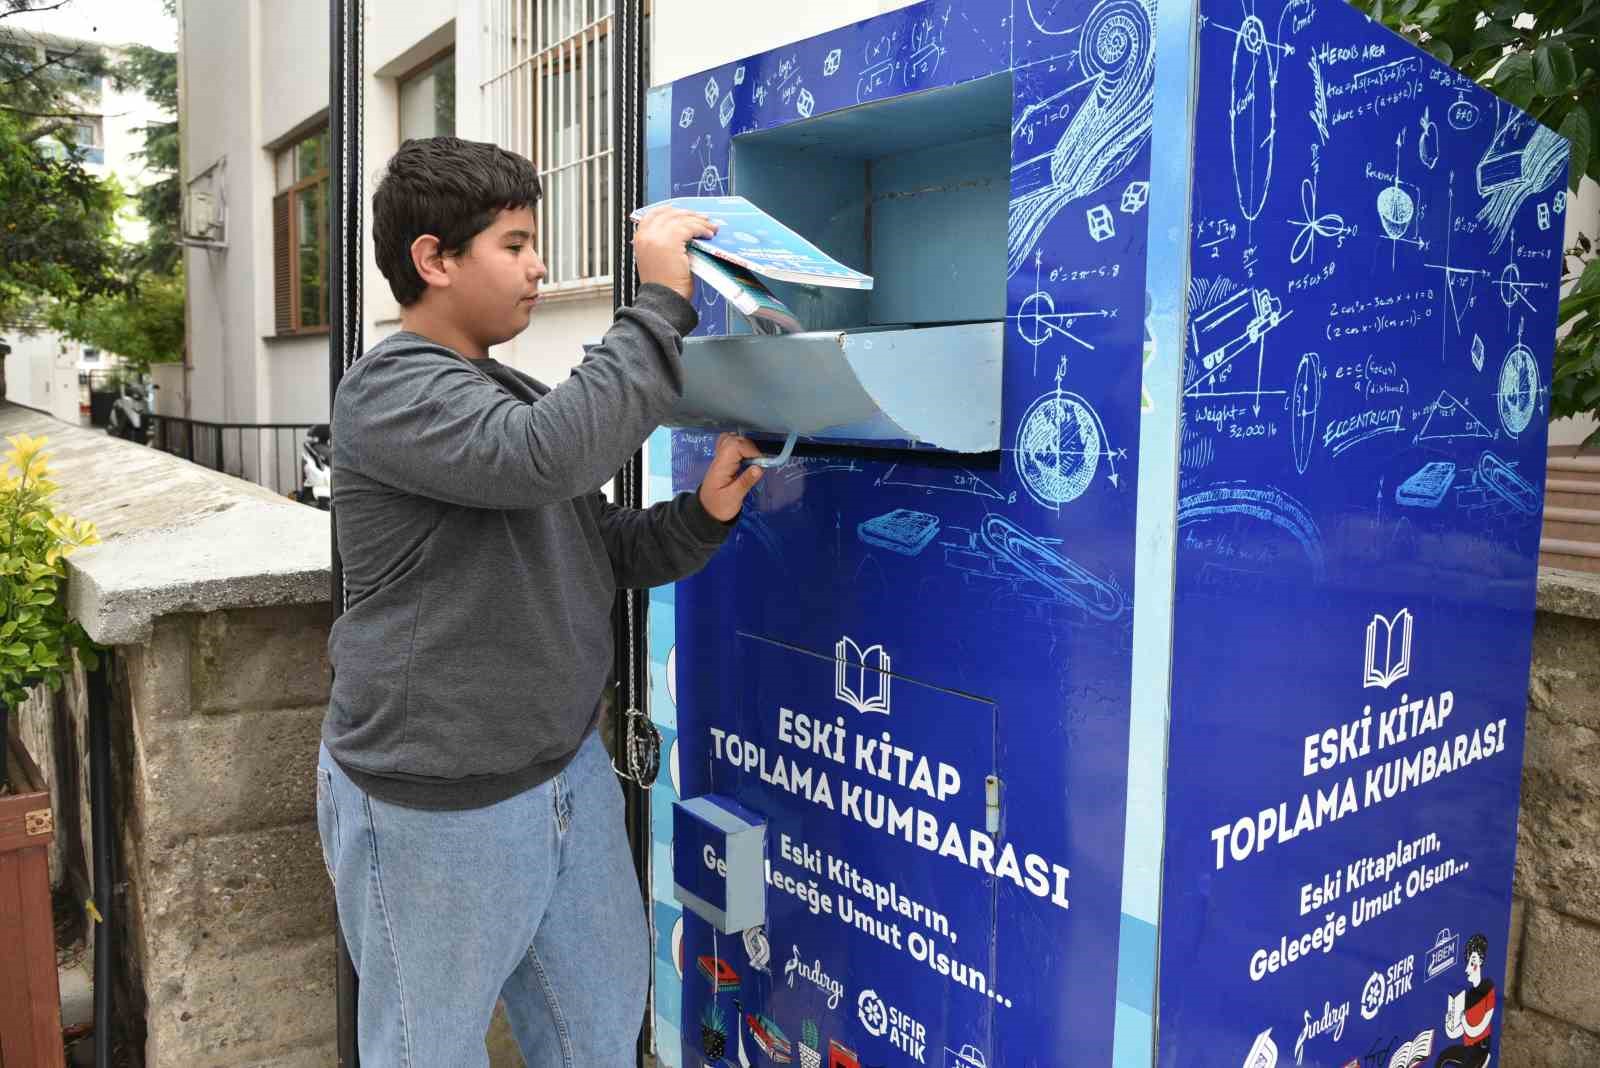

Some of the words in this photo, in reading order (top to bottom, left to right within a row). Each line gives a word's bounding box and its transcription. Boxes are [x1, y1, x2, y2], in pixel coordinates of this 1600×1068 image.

[1229, 423, 1266, 441] 32,000
[778, 707, 847, 764] ESKİ
[855, 731, 961, 801] KİTAP
[1303, 704, 1373, 777] ESKİ
[1378, 689, 1454, 750] KİTAP
[710, 727, 835, 811] TOPLAMA
[841, 780, 1071, 910] KUMBARASI
[1211, 776, 1359, 870] TOPLAMA
[1364, 718, 1507, 809] KUMBARASI
[780, 832, 822, 875] Eski
[827, 855, 958, 944] Kitapların,
[1300, 869, 1342, 916] Eski
[1346, 832, 1441, 893] Kitapların,
[838, 894, 902, 951] Umut
[908, 931, 1012, 1009] Olsun...
[1249, 911, 1347, 982] Geleceğe
[1351, 881, 1402, 928] Umut
[1406, 857, 1470, 898] Olsun...
[1385, 971, 1413, 1005] ATIK
[1387, 953, 1415, 985] SIFIR
[888, 1006, 926, 1045] SIFIR
[888, 1025, 926, 1065] ATIK
